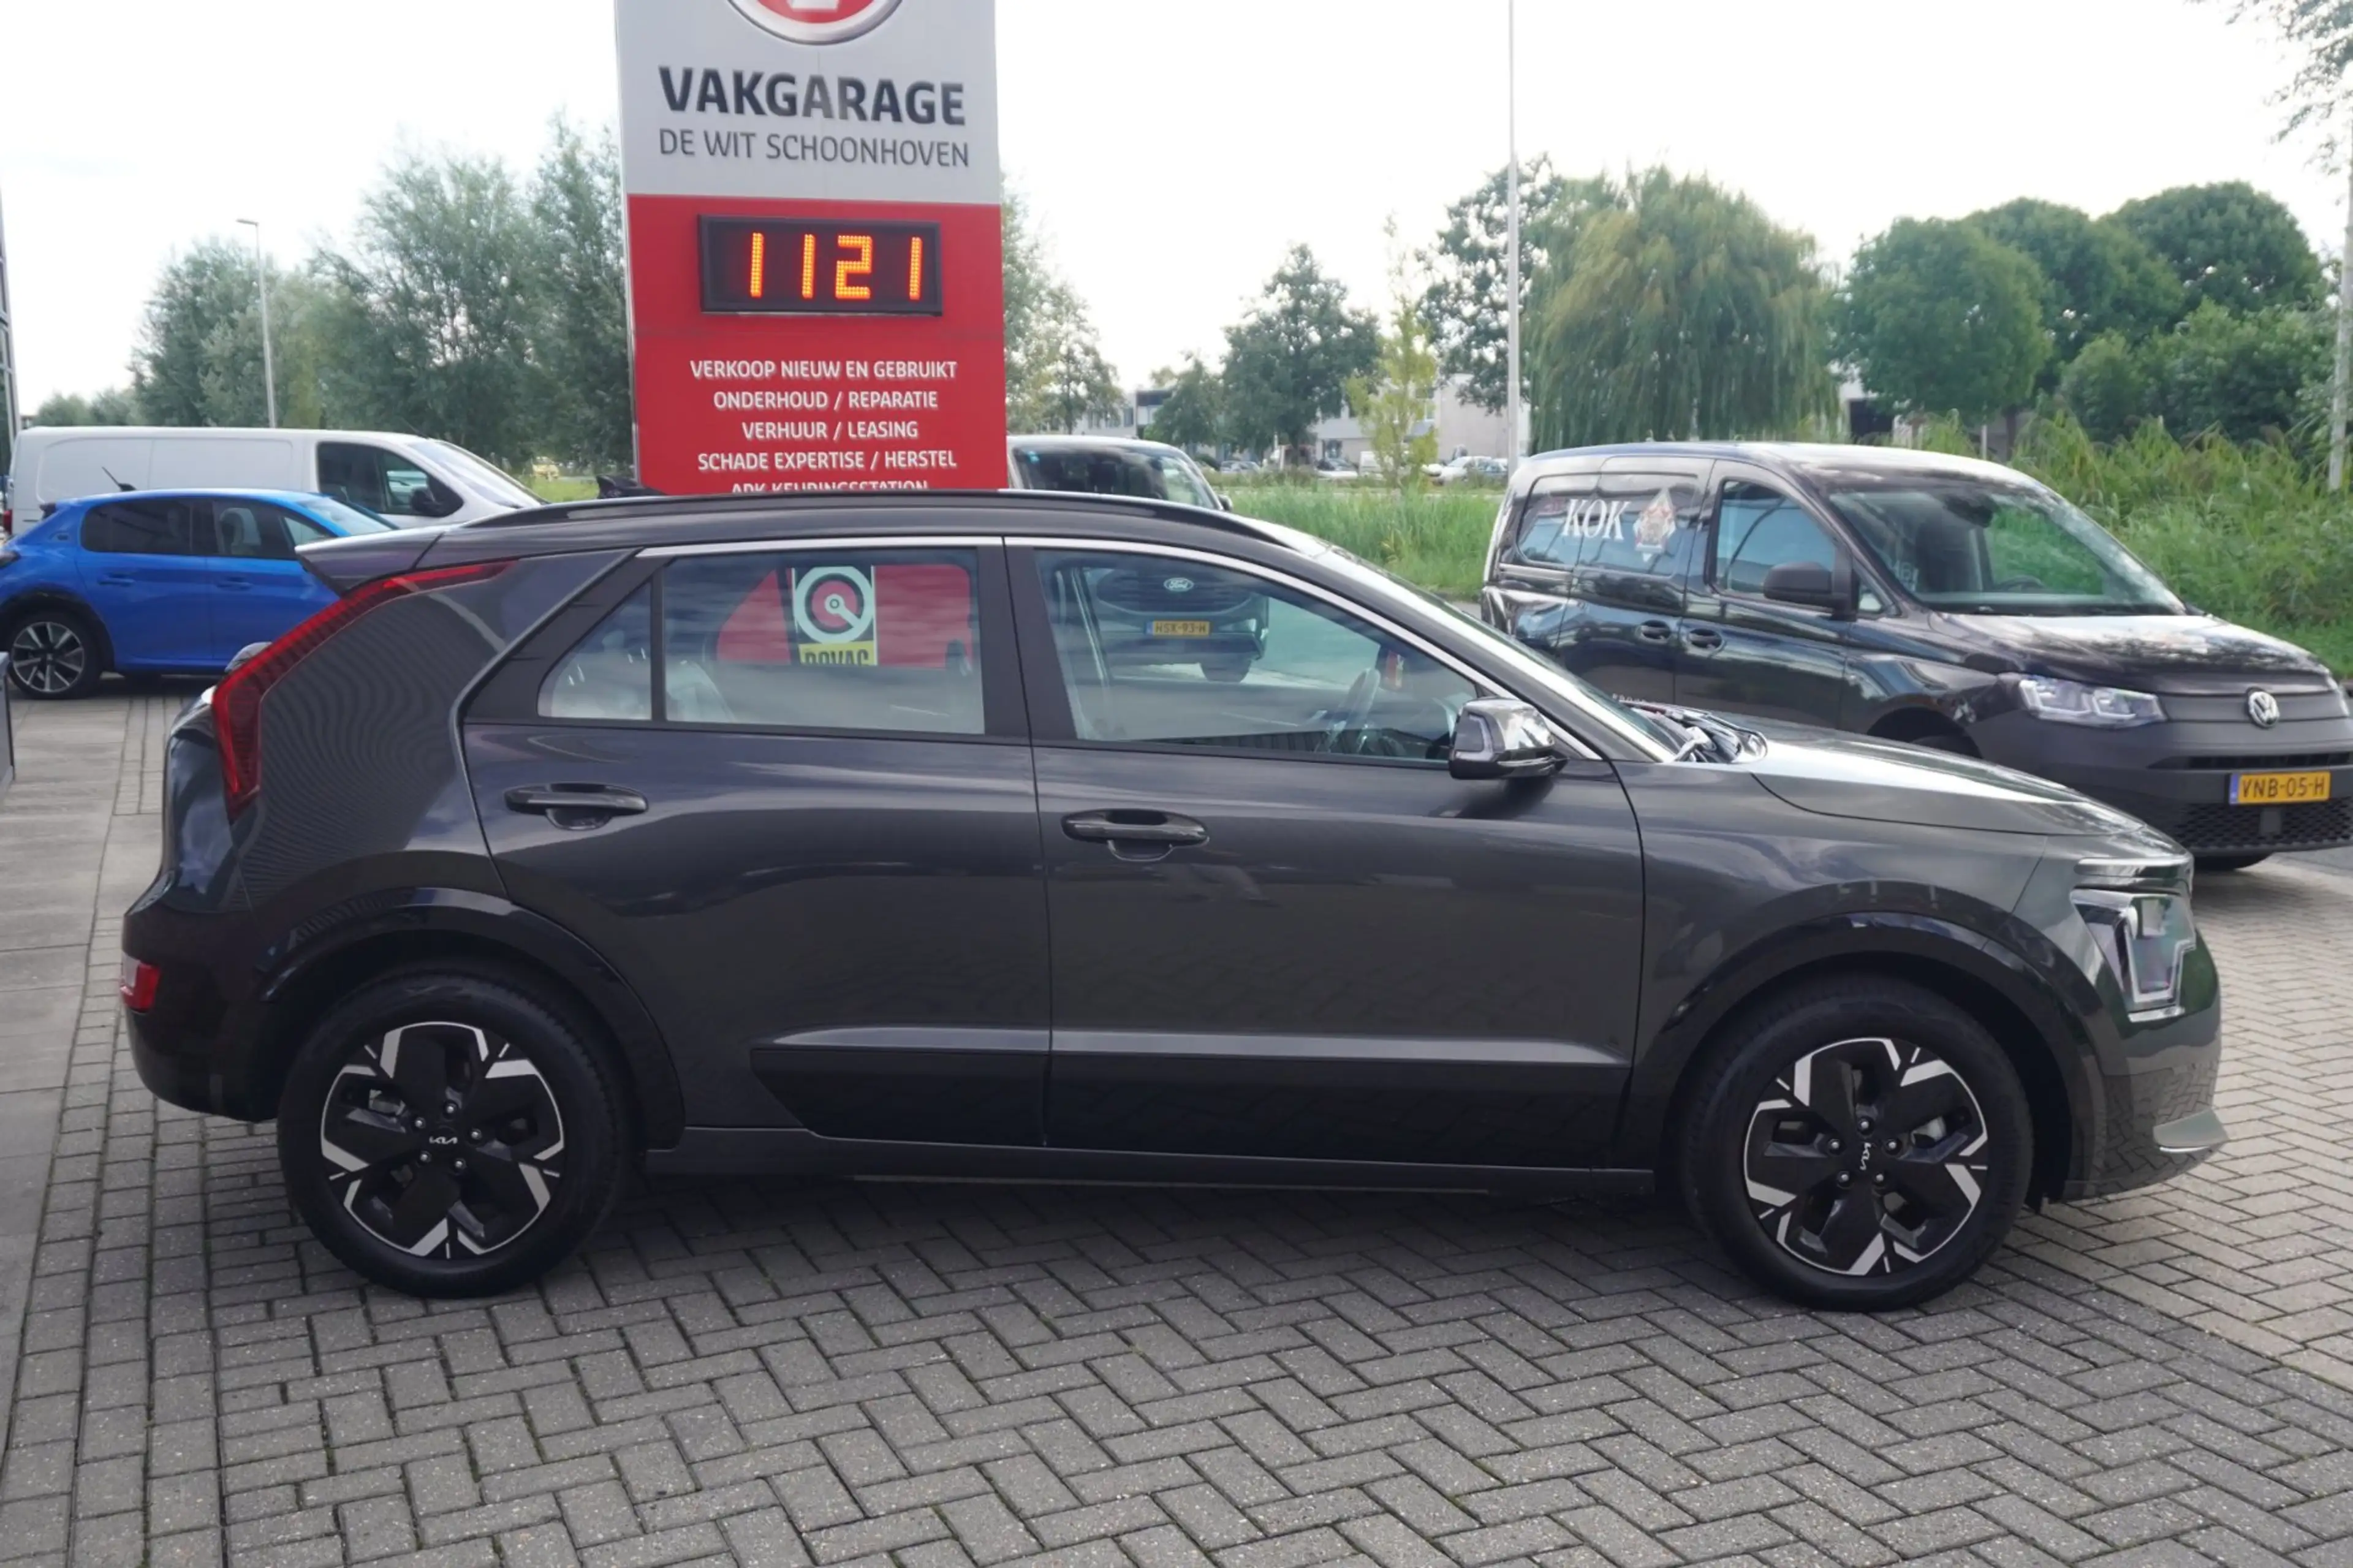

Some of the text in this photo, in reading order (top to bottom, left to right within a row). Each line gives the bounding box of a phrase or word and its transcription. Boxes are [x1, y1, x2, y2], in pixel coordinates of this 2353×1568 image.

[659, 66, 966, 126] VAKGARAGE
[659, 128, 969, 167] DE WIT SCHOONHOVEN
[691, 360, 957, 380] VERKOOP NIEUW EN GEBRUIKT
[714, 391, 938, 411] ONDERHOUD / REPARATIE
[742, 421, 918, 441] VERHUUR / LEASING
[698, 450, 957, 471] SCHADE EXPERTISE / HERSTEL
[1563, 499, 1632, 540] KOK
[2242, 776, 2325, 798] VNB-05-H
